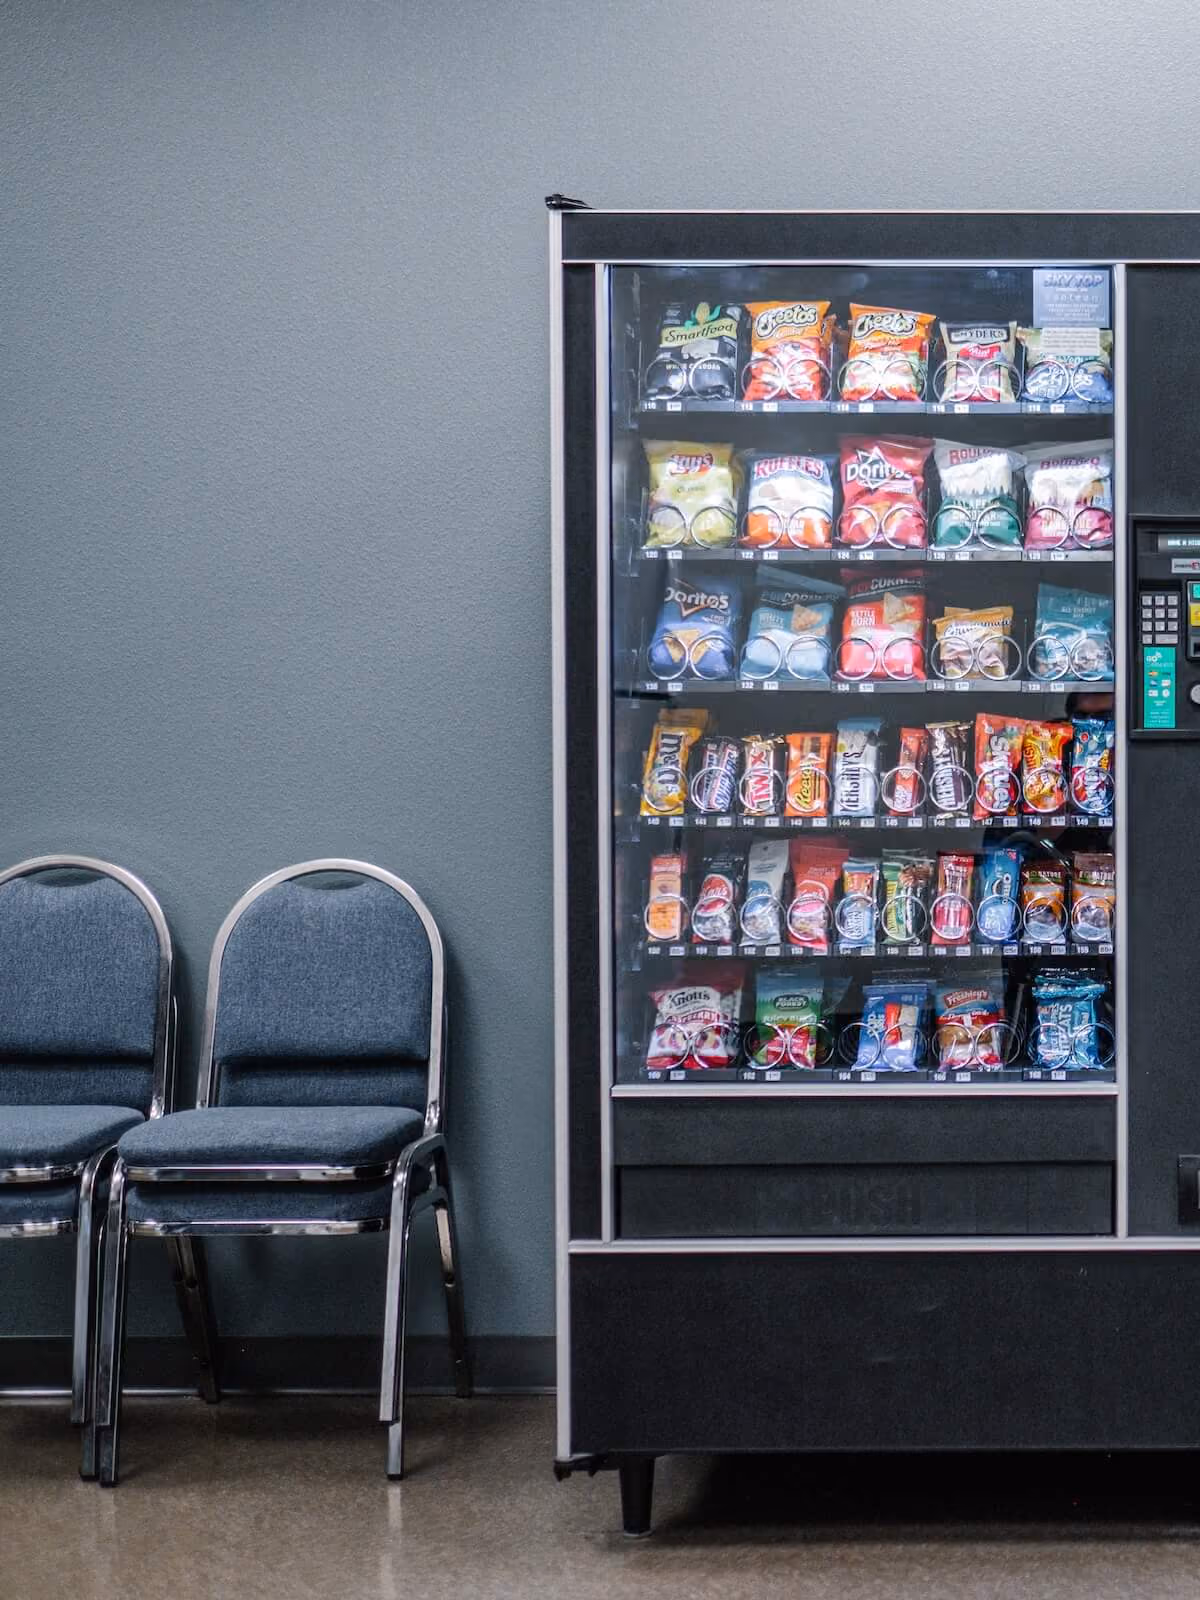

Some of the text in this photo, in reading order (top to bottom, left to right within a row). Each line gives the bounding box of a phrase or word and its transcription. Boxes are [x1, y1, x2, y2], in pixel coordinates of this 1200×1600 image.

[664, 323, 733, 343] Smartfood
[756, 305, 818, 338] Cheetos
[664, 587, 729, 609] Doritos
[751, 751, 769, 807] TWIX
